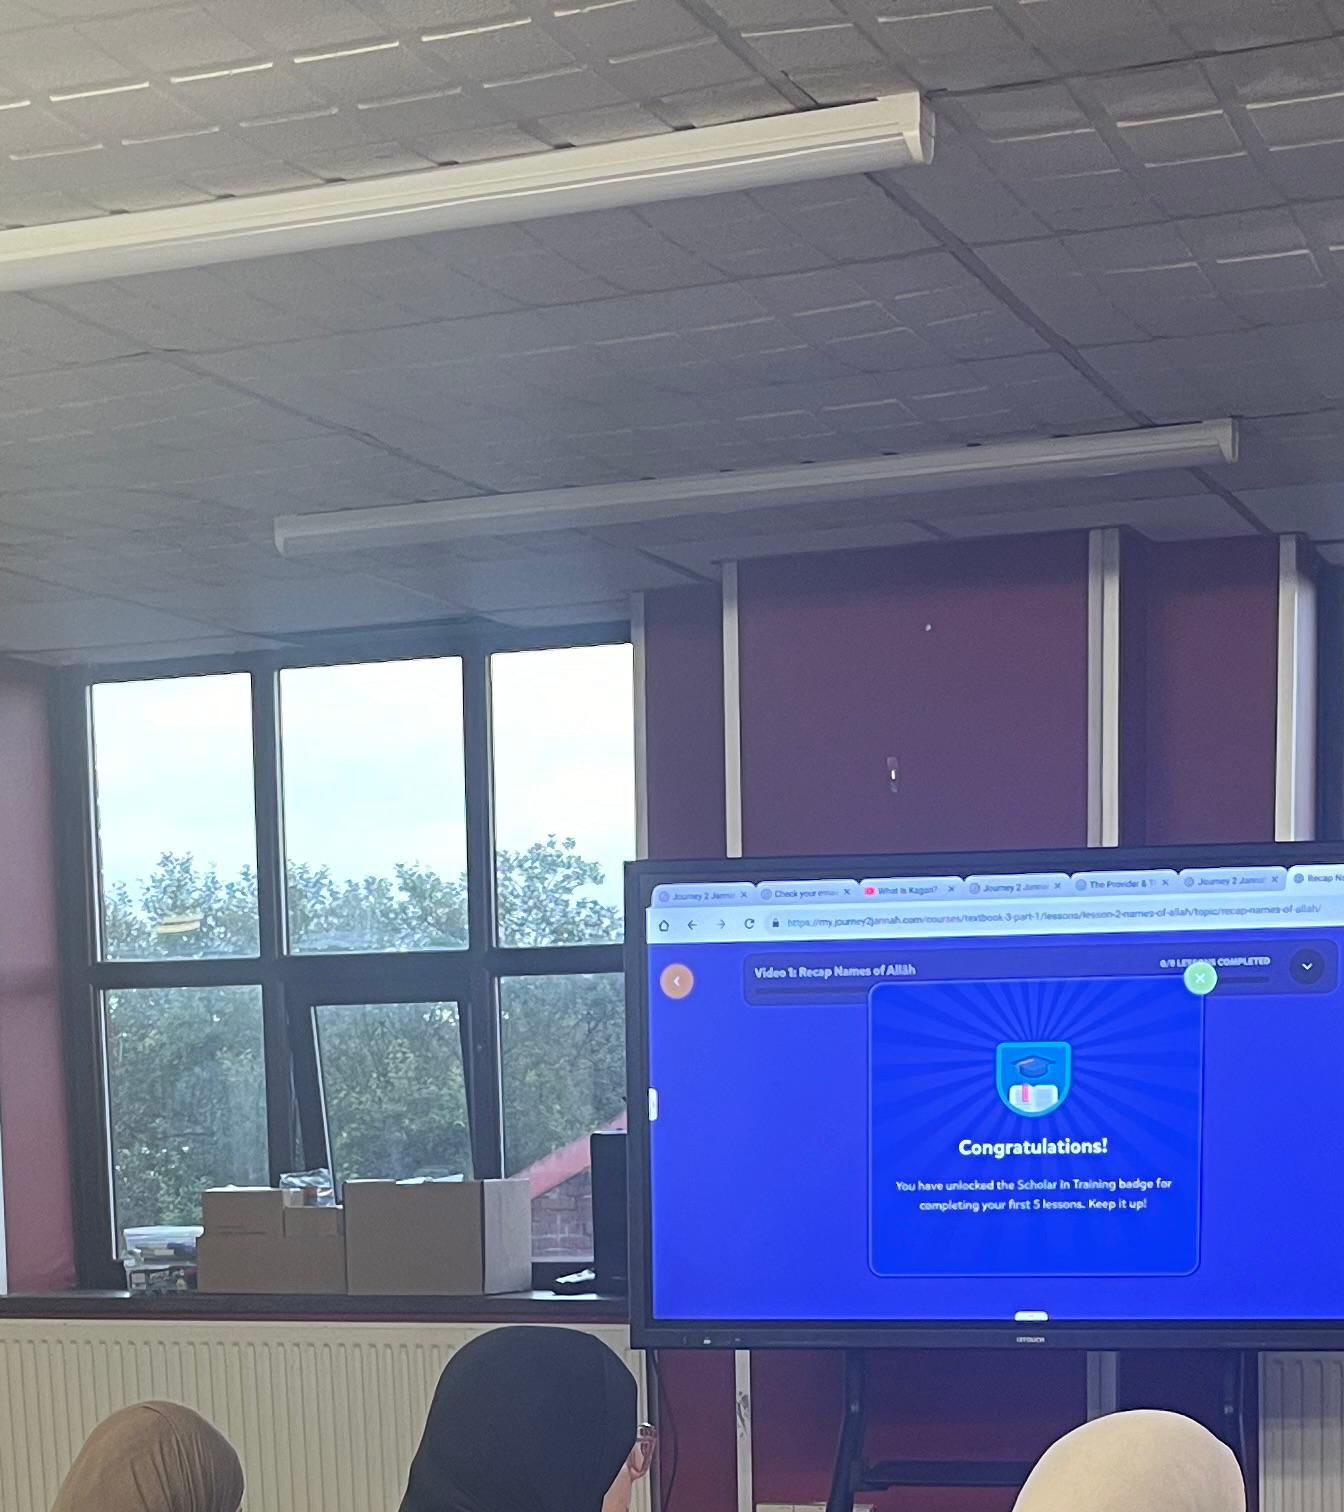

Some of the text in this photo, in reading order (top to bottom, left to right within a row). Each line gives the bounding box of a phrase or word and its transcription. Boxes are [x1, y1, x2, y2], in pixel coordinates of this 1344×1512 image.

[1090, 879, 1105, 889] The
[1308, 873, 1334, 884] Recap
[775, 889, 798, 898] Check
[799, 890, 817, 900] your
[878, 886, 899, 895] What
[1217, 956, 1272, 967] COMPLETED
[755, 966, 787, 979] Video
[799, 966, 833, 980] Recap
[834, 965, 872, 977] Names
[873, 964, 886, 976] of
[958, 1137, 1108, 1159] Congratulations!
[896, 1181, 916, 1191] You
[918, 1180, 944, 1191] have
[945, 1180, 995, 1191] unlocked
[997, 1180, 1015, 1190] the
[1017, 1179, 1057, 1190] Scholar
[1072, 1178, 1117, 1192] Training
[1118, 1178, 1154, 1191] badge
[1156, 1177, 1173, 1189] for
[919, 1197, 1148, 1213] completing your first 5 lessons. Keep it up!
